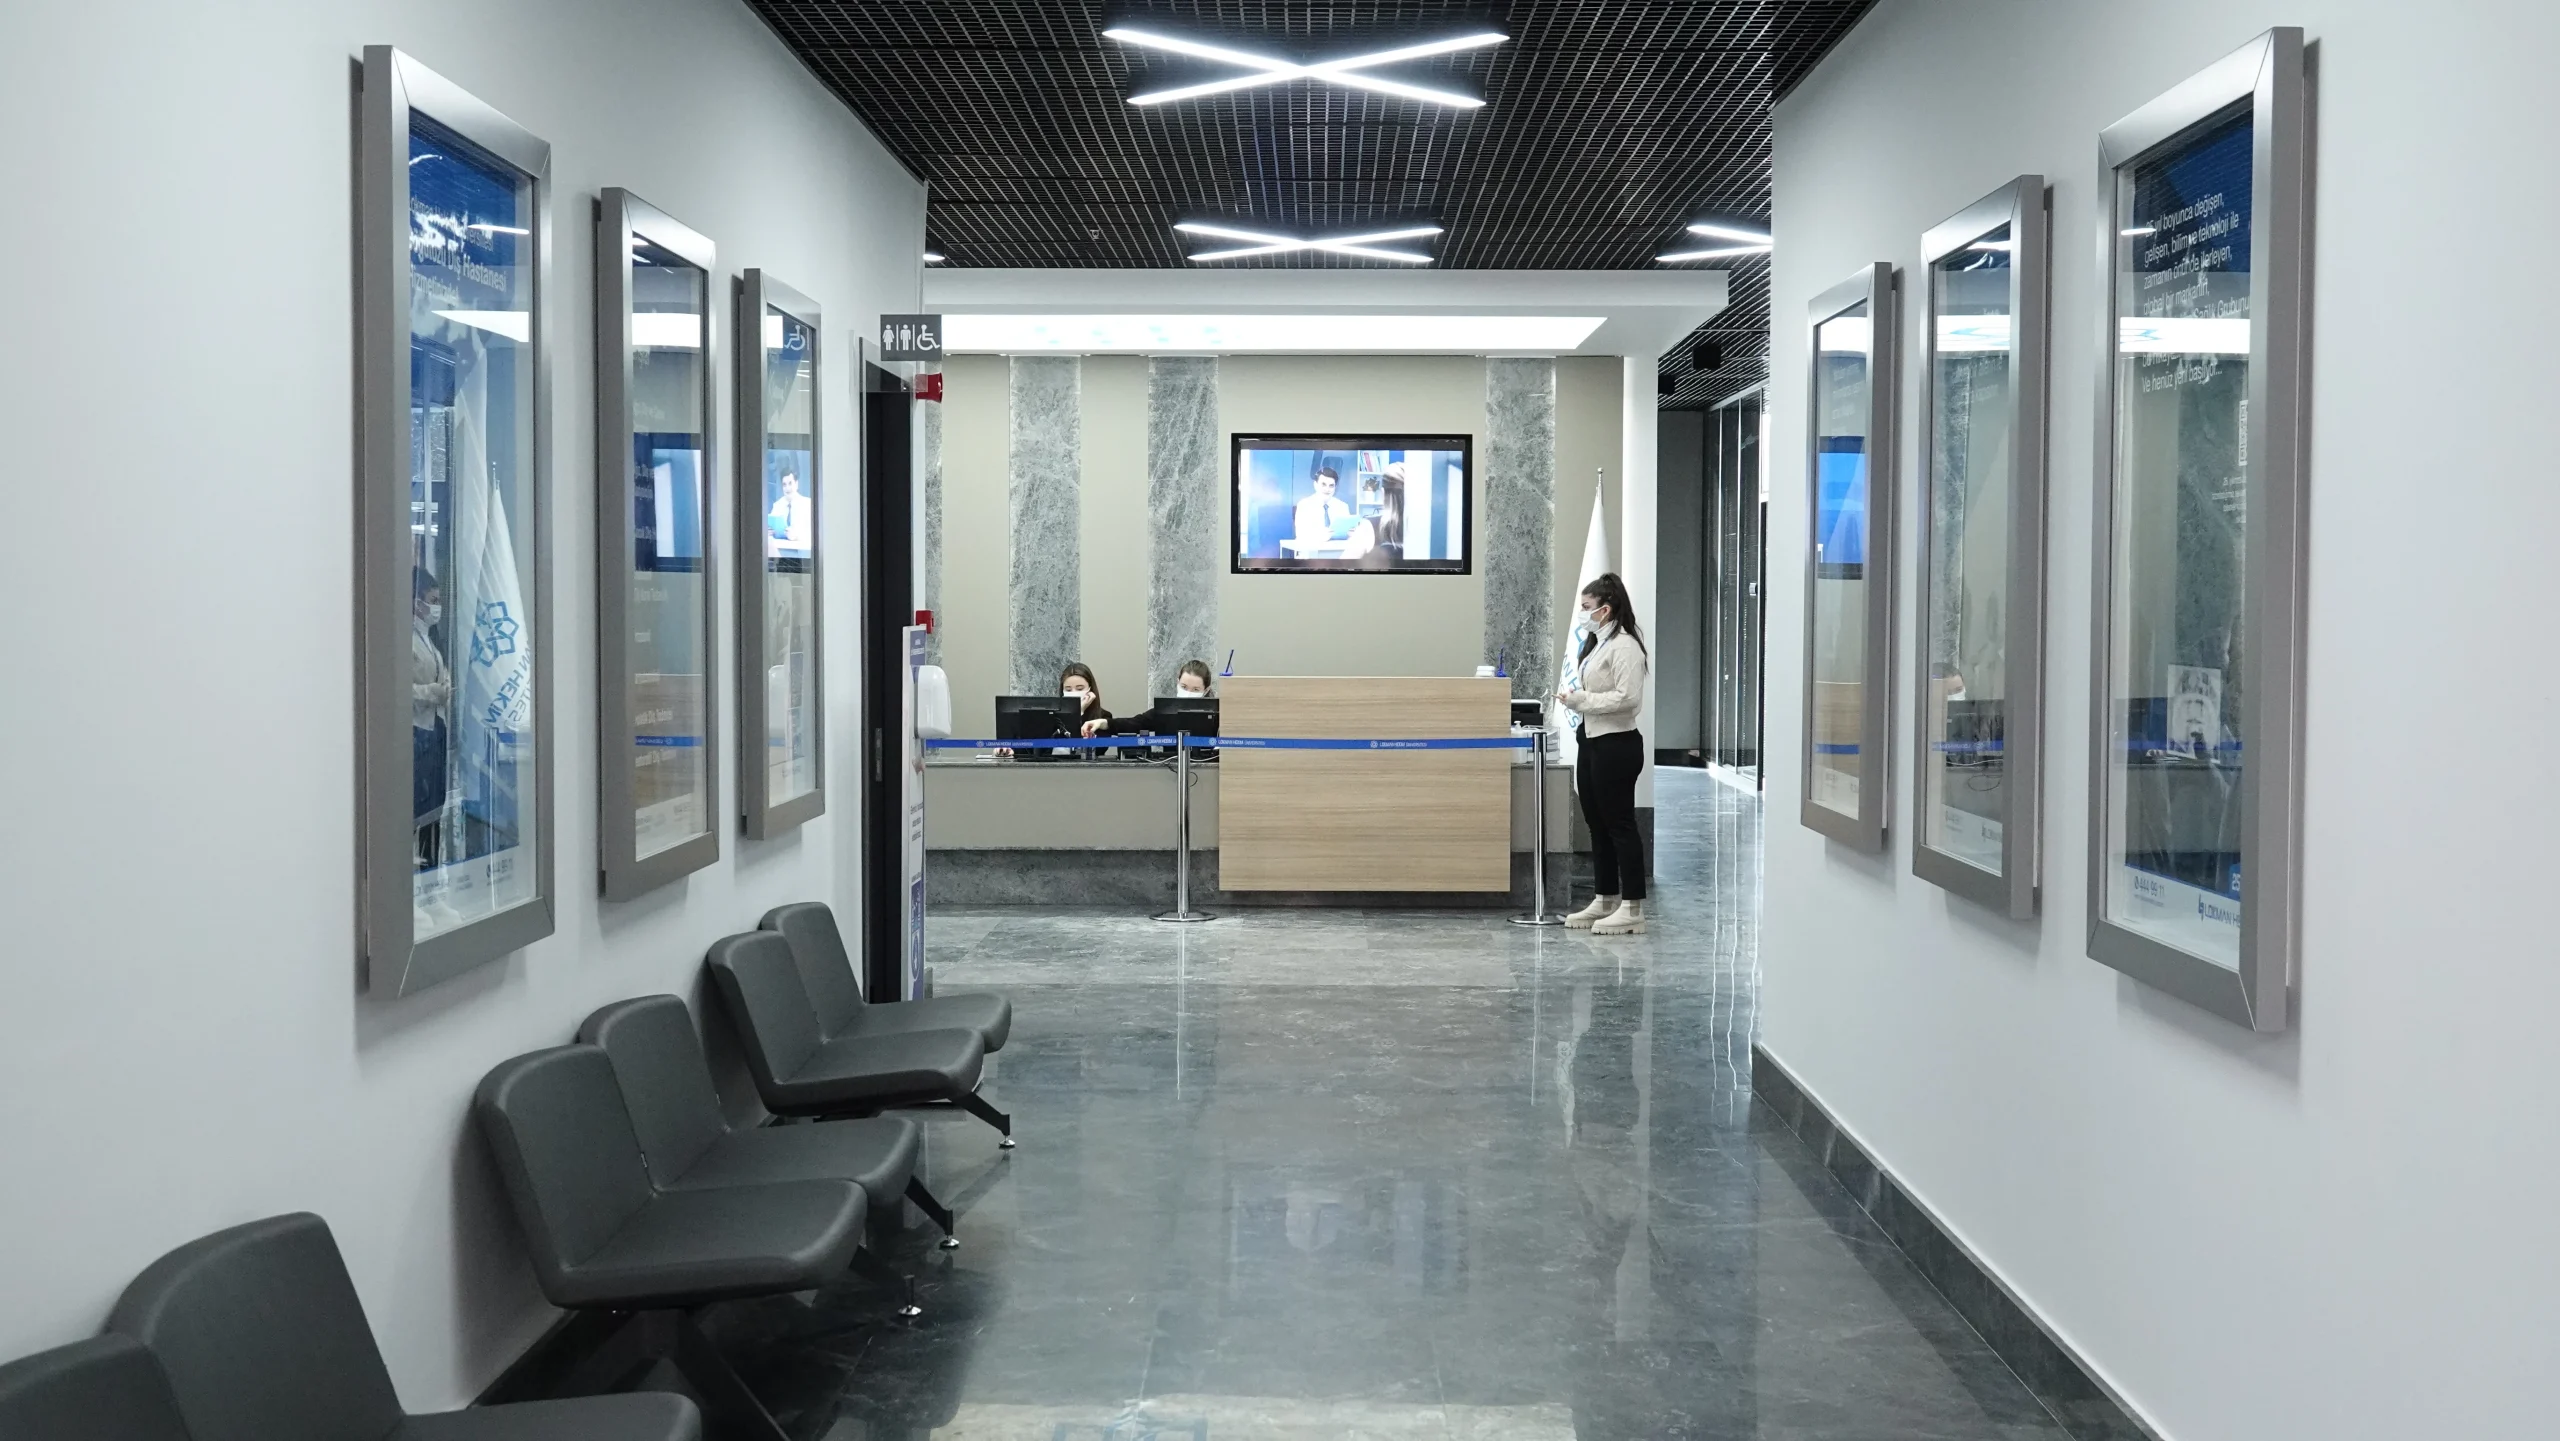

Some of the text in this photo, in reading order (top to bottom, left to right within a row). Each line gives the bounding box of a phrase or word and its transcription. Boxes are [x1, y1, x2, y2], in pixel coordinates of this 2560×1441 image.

[2163, 205, 2194, 231] boyunca
[2194, 192, 2225, 218] değişen,
[2144, 242, 2170, 268] gelişen,
[2171, 233, 2188, 254] bilim
[2198, 213, 2229, 243] teknoloji
[2230, 210, 2239, 230] ile
[462, 252, 507, 294] Hastanesi
[2143, 266, 2173, 290] zamanın
[2142, 374, 2152, 393] Ve
[2151, 369, 2173, 391] henüz
[2204, 904, 2232, 926] LOKMAN
